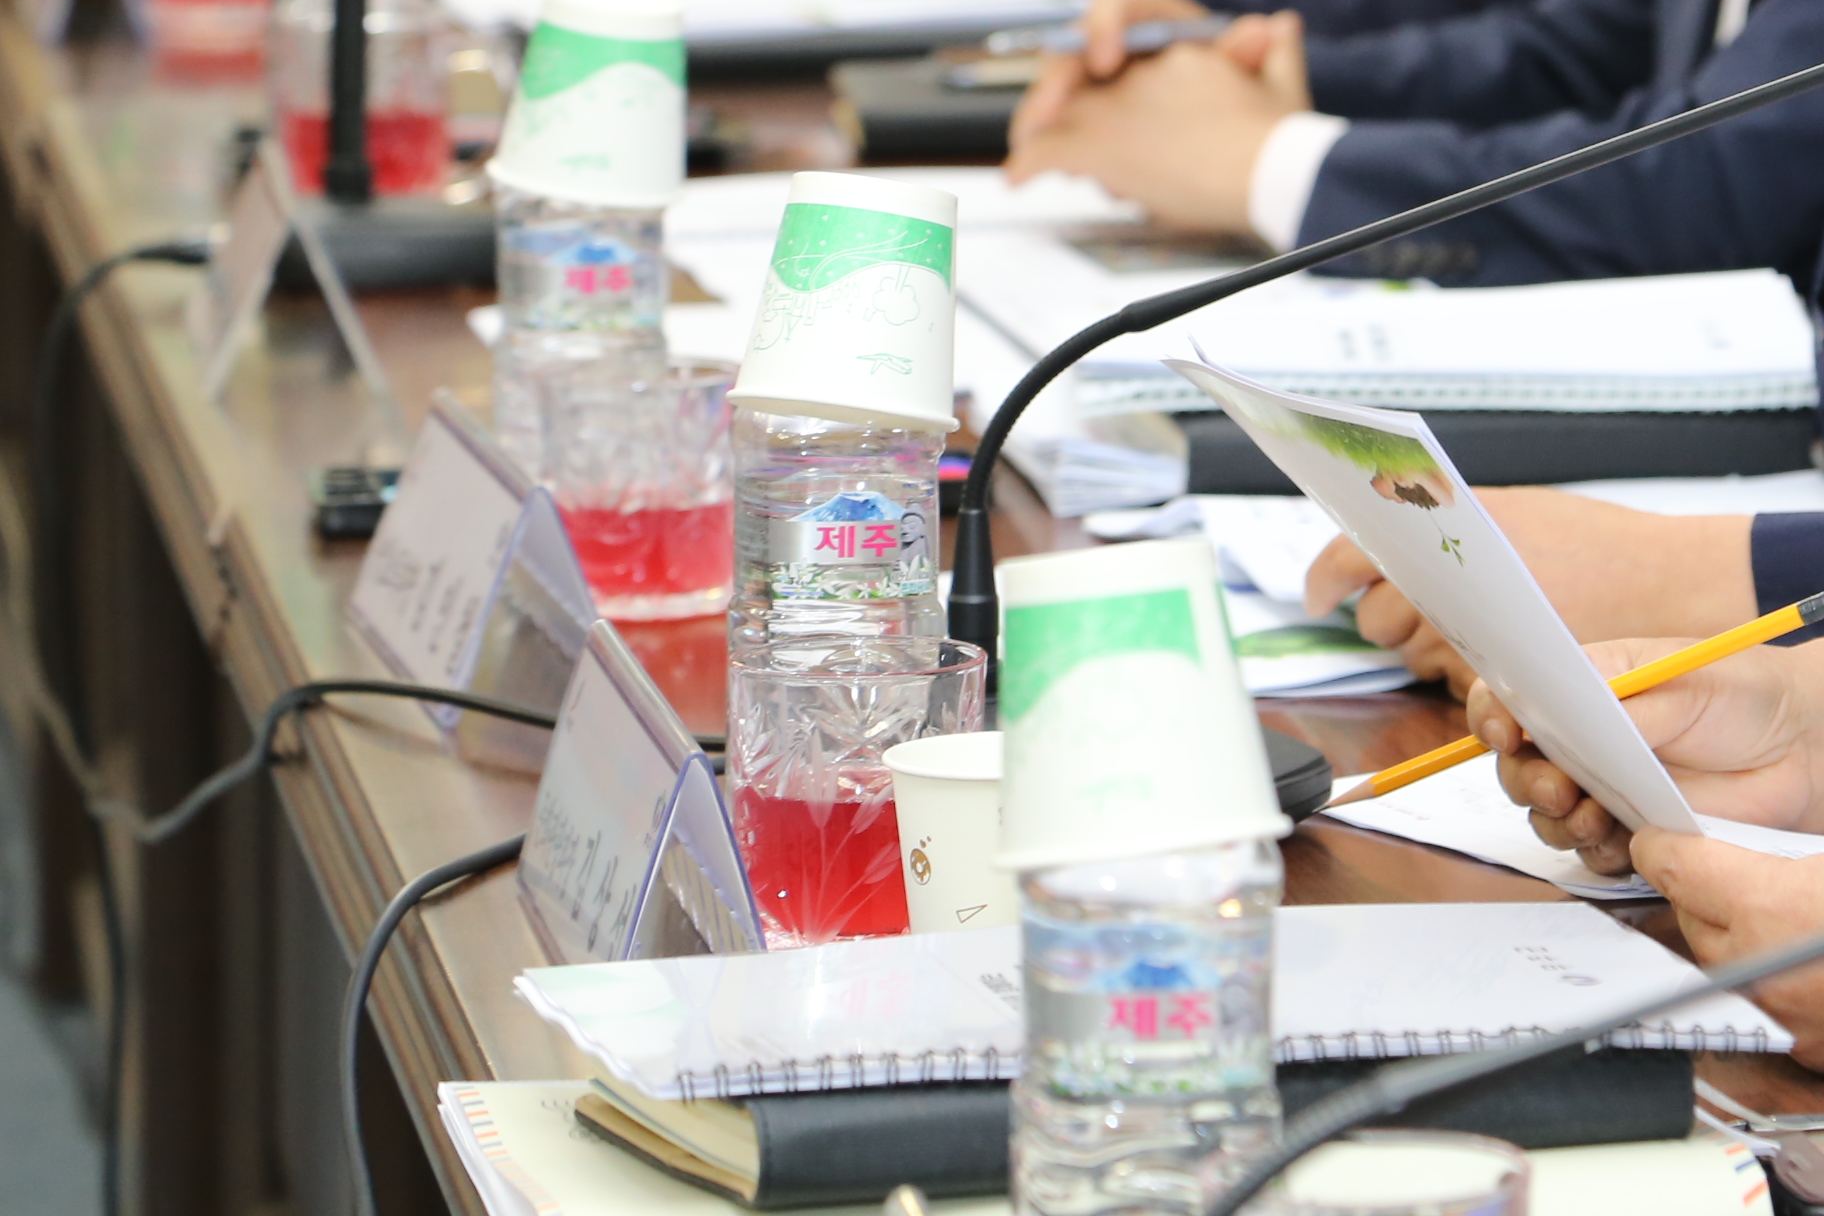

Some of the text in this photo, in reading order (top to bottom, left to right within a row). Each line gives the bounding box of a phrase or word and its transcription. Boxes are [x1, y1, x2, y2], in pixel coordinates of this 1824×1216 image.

[566, 266, 634, 295] 제주
[814, 525, 898, 558] 제주
[1108, 993, 1213, 1040] 제주
